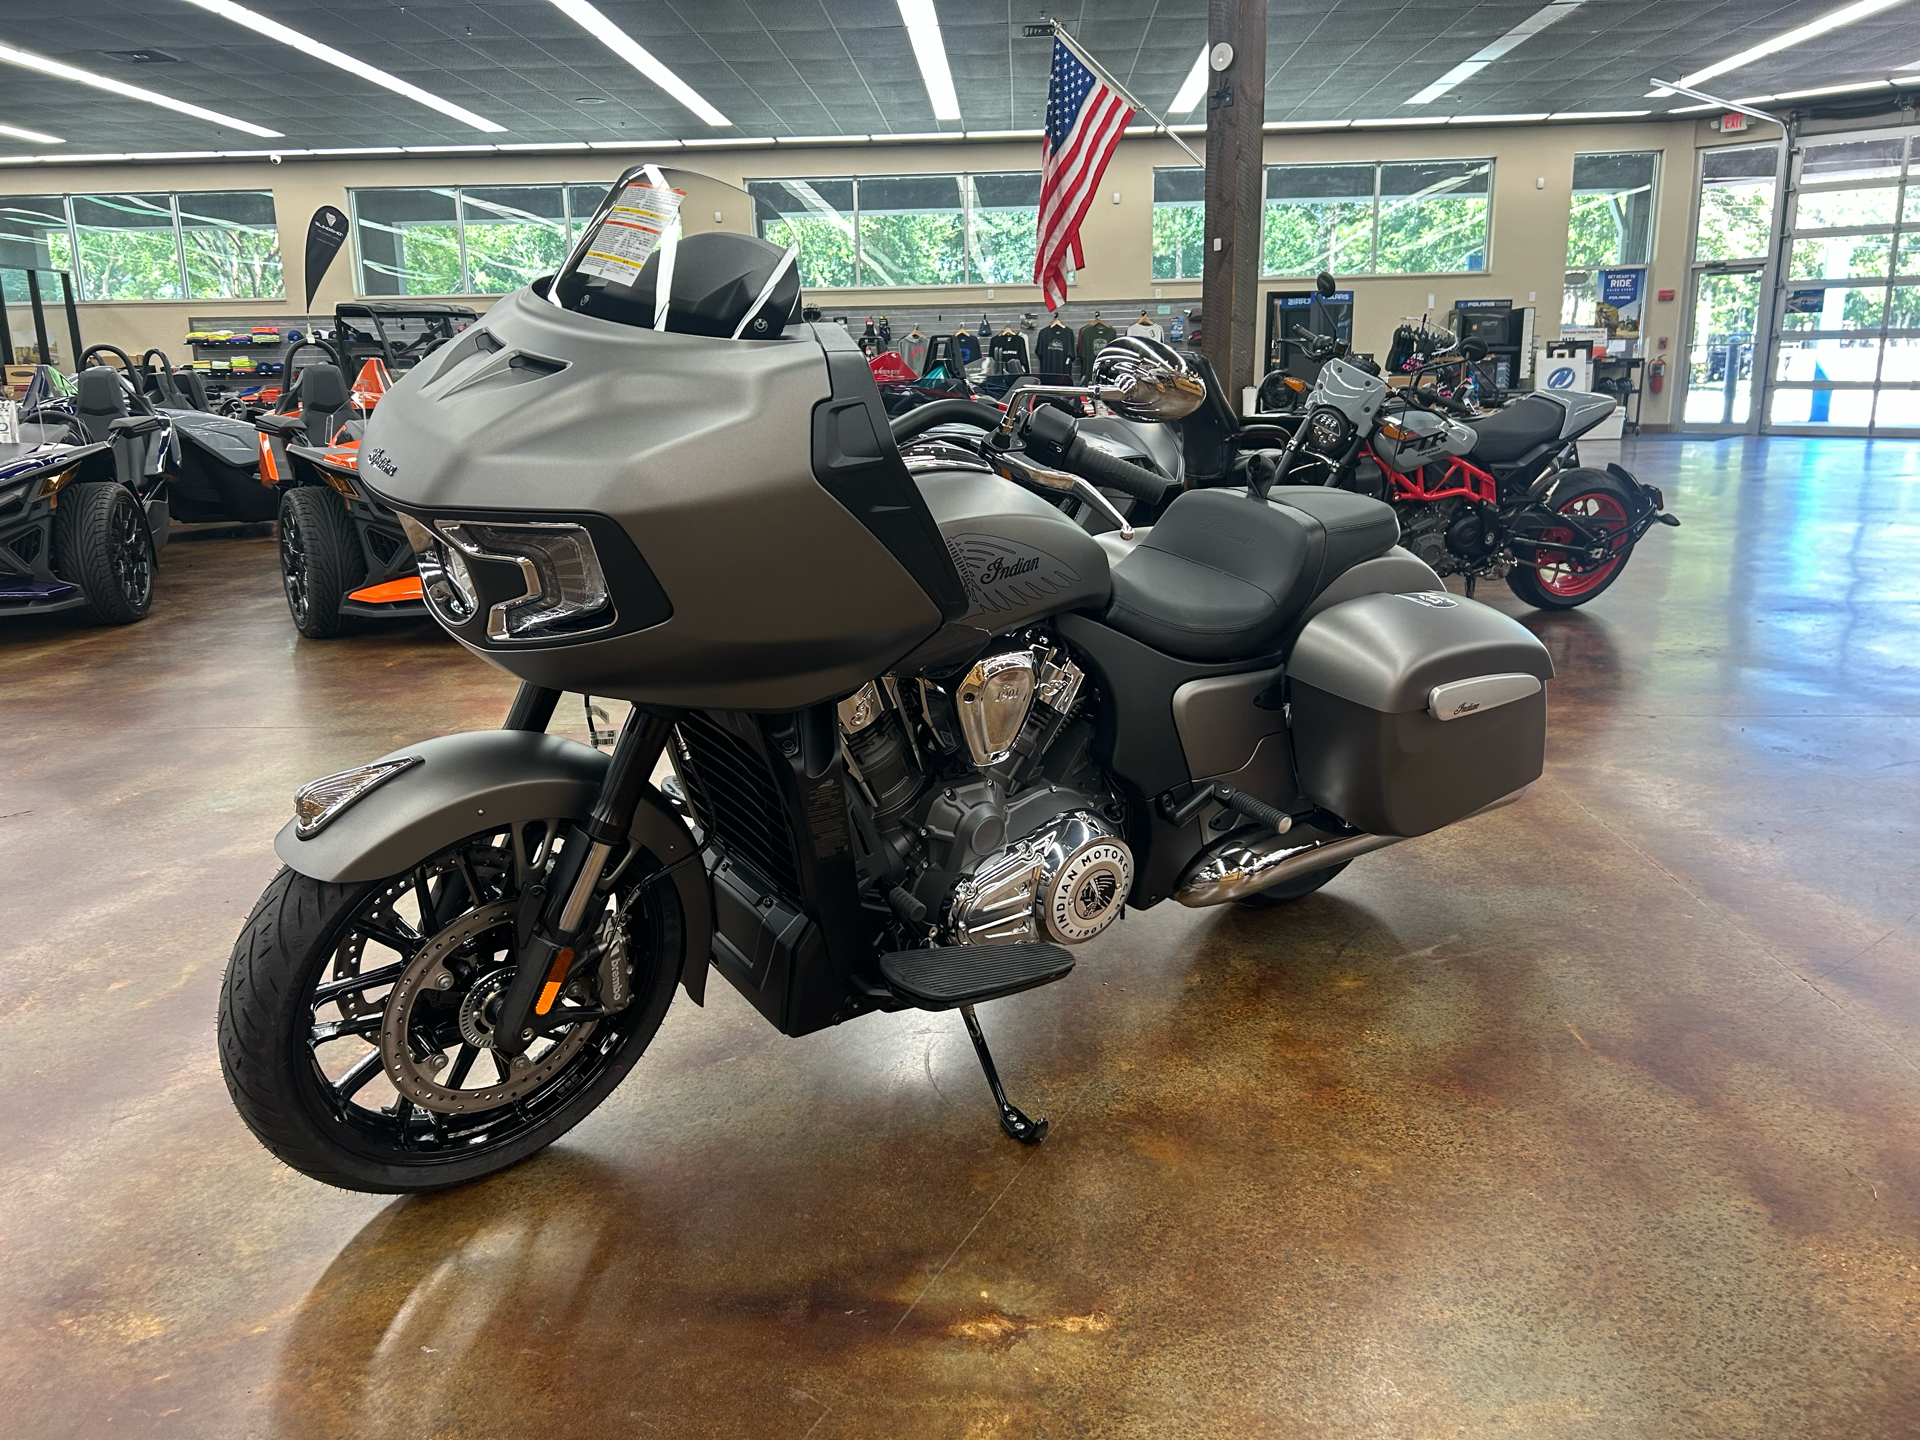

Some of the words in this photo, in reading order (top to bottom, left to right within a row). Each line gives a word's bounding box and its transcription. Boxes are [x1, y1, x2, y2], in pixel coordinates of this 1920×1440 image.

[1725, 113, 1744, 129] EXIT
[1610, 279, 1632, 288] RIDE
[1397, 430, 1449, 455] FTR
[1417, 448, 1441, 457] 1200
[980, 556, 1040, 585] Indian
[995, 687, 1019, 703] 1901
[1453, 701, 1480, 716] Indian
[1056, 869, 1079, 930] INDIAN
[1081, 848, 1129, 910] MOTORCYCLE
[610, 957, 623, 1001] brembo
